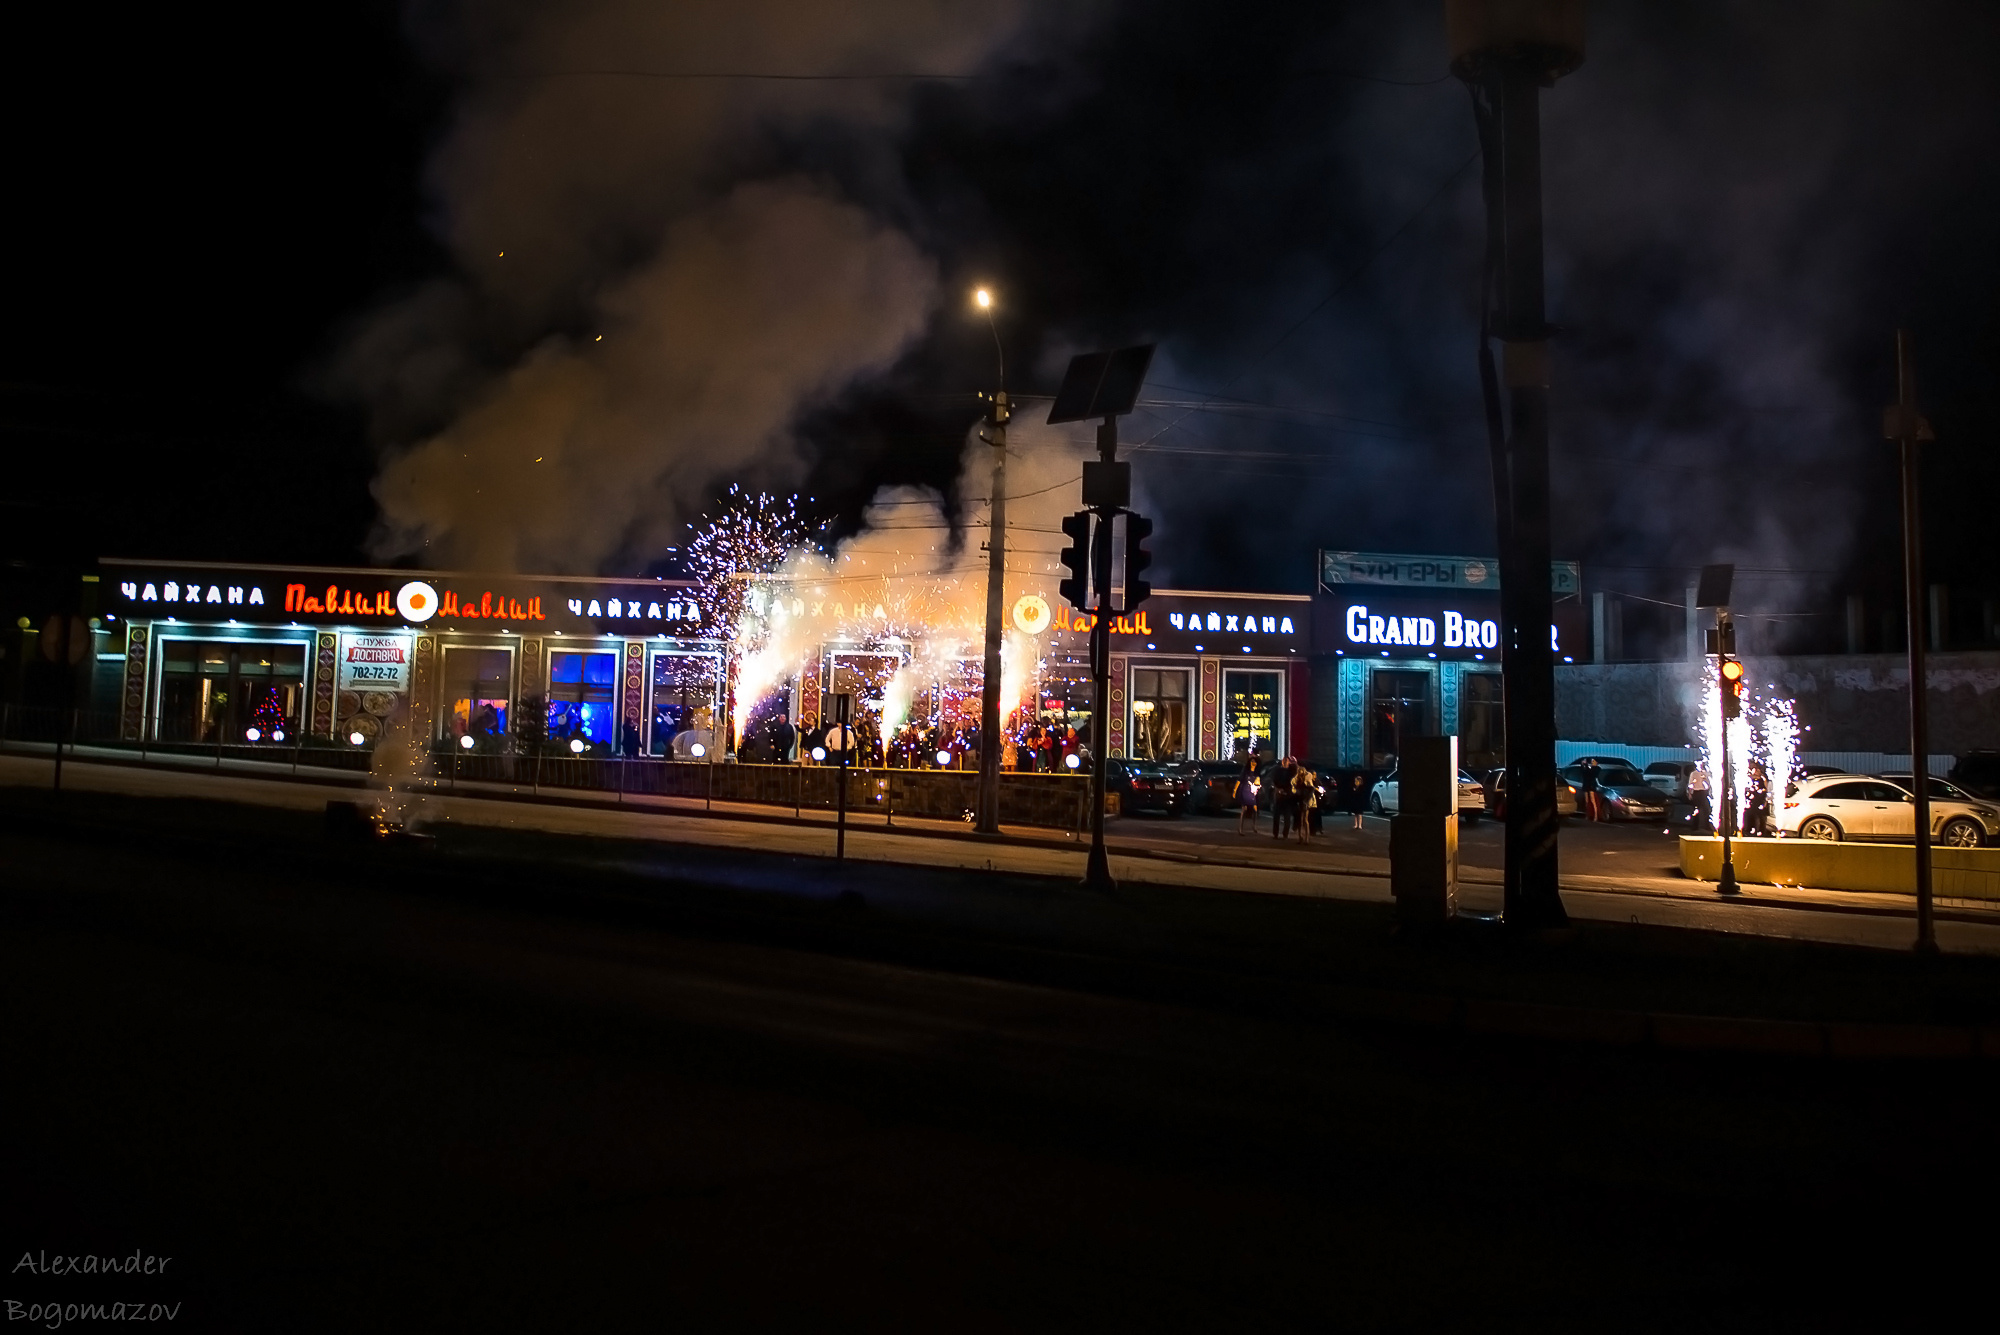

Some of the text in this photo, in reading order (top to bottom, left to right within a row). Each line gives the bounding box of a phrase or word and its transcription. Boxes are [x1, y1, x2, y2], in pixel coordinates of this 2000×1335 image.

[1349, 561, 1456, 583] БУРГЕРЫ
[121, 581, 265, 605] ЧАЙХАНА
[285, 583, 546, 621] Павлин Мавлин
[567, 597, 702, 622] ЧАЙХАНА
[1052, 604, 1152, 635] Маин
[1169, 611, 1295, 635] ЧАЙХАНА
[355, 637, 398, 647] СЛУЖБА
[351, 648, 400, 662] ДОСТАВКИ
[352, 666, 399, 680] 702-72-72
